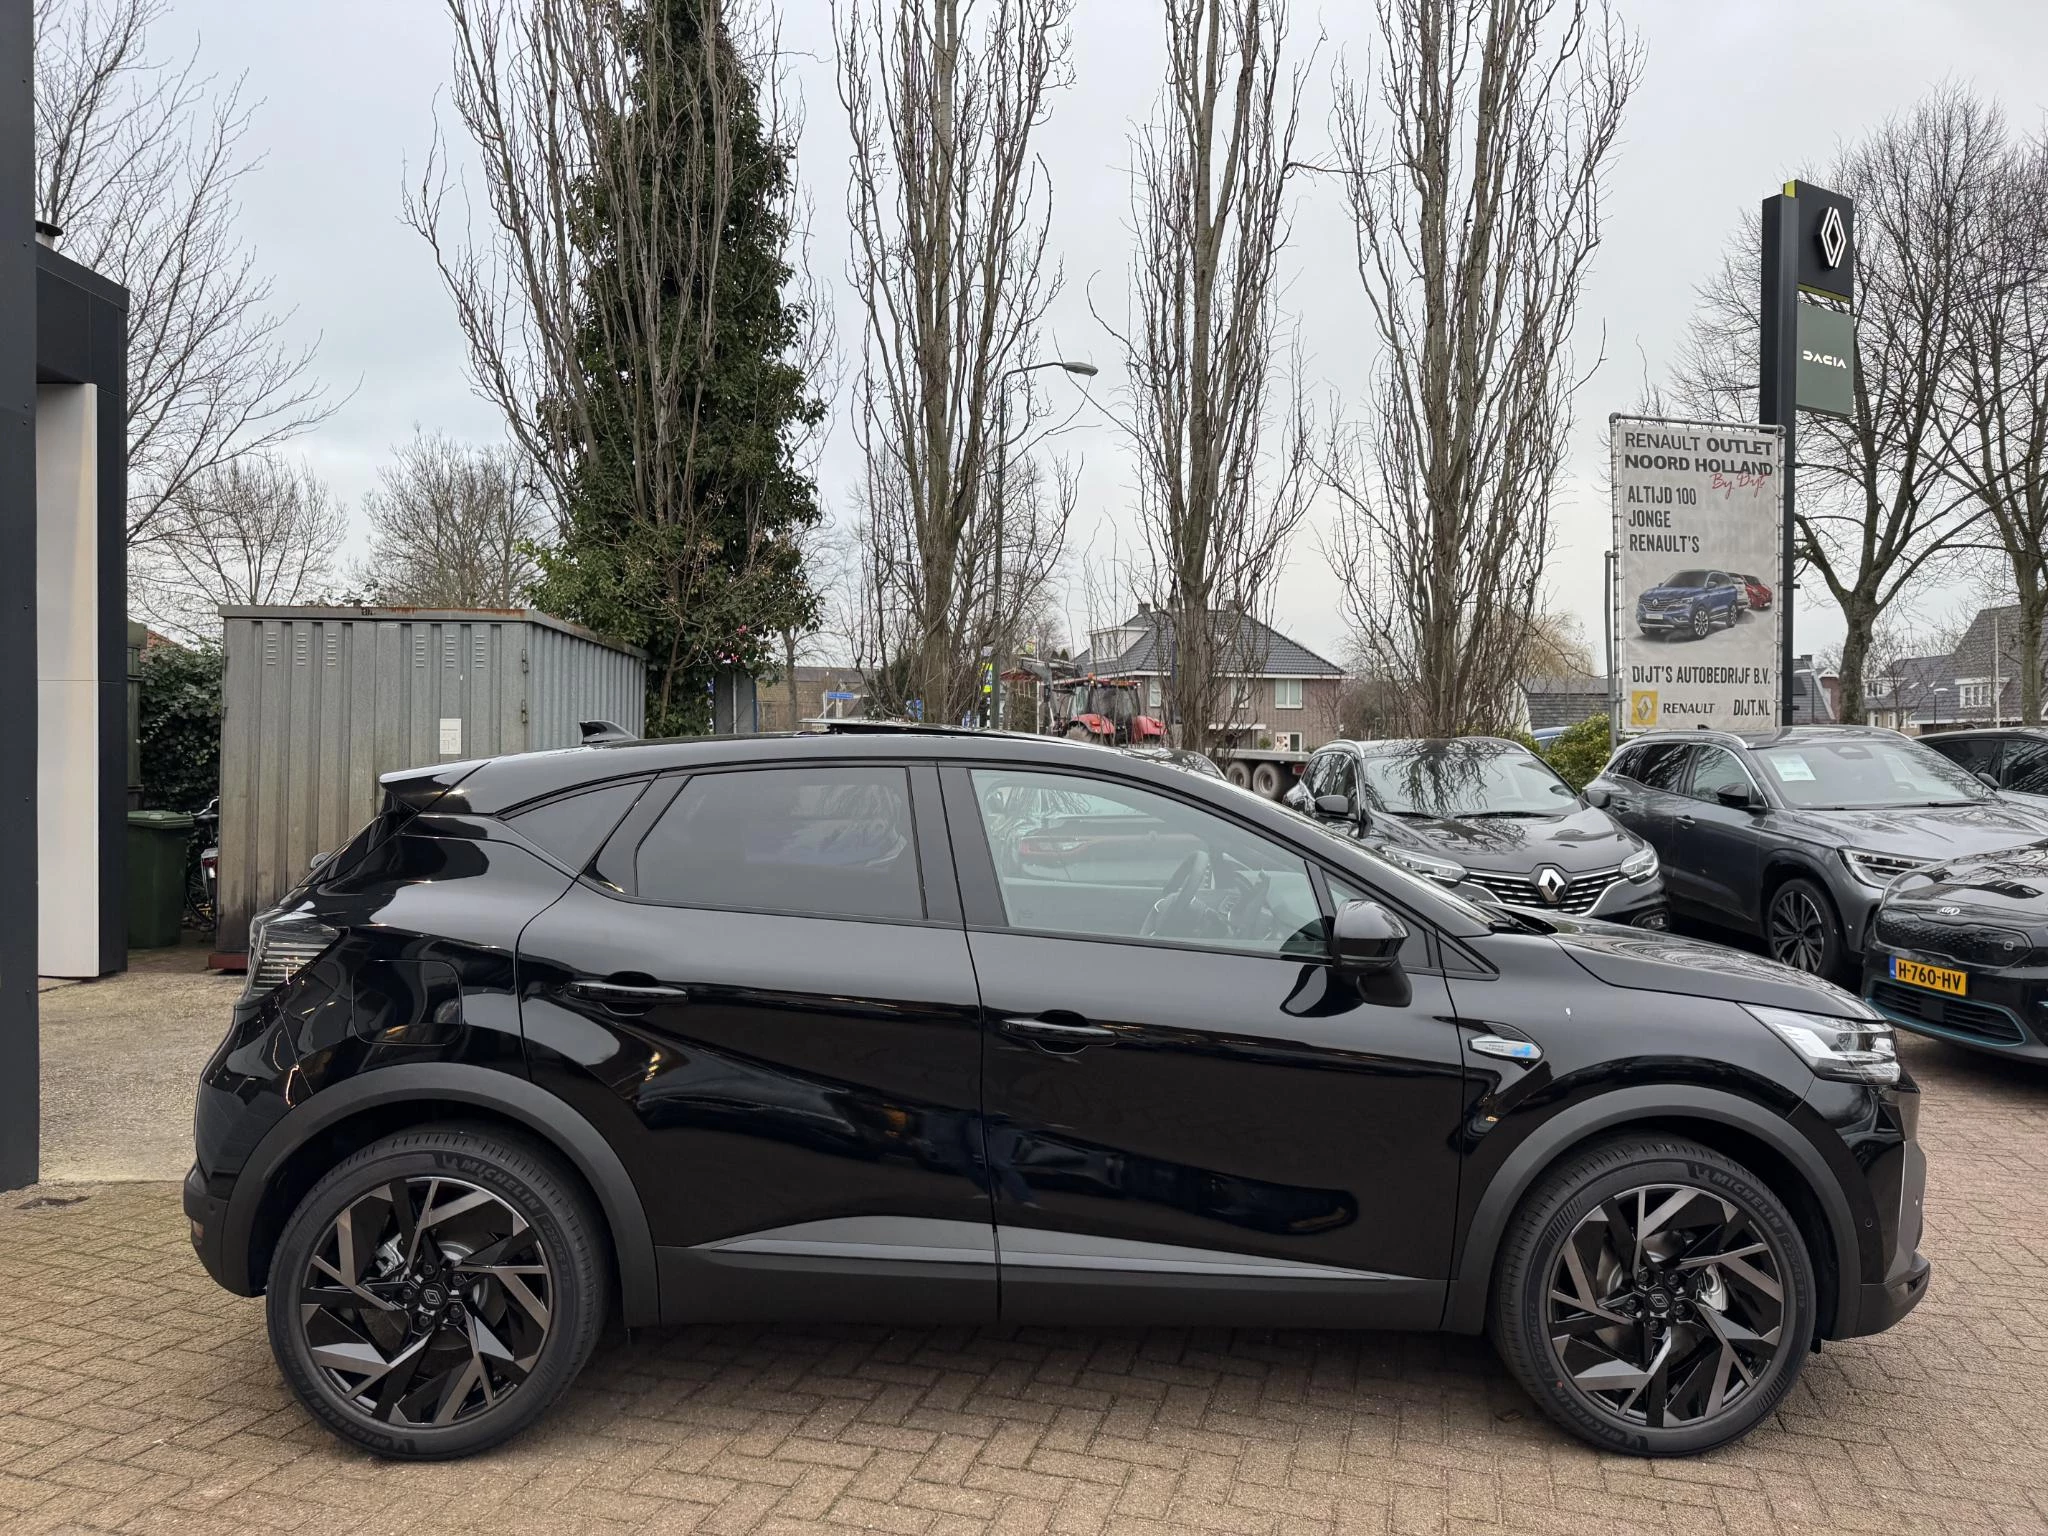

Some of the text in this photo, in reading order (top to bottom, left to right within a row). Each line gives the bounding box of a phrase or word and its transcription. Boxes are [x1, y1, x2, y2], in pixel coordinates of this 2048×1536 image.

[1803, 350, 1847, 369] DACIA
[1625, 432, 1773, 456] RENAULT OUTLET
[1624, 454, 1773, 476] NOORD HOLLAND
[1628, 485, 1697, 505] ALTIJD 100
[1710, 472, 1734, 499] By
[1628, 509, 1671, 528] JONGE
[1629, 533, 1700, 553] RENAULT'S
[1632, 665, 1771, 685] DIJT'S AUTOBEDRIJF B.V.
[1663, 698, 1771, 716] RENAULT DIJT.NL
[1898, 961, 1962, 992] H-760-HV
[460, 1159, 540, 1211] MICHELIN
[1712, 1172, 1784, 1229] MICHELIN
